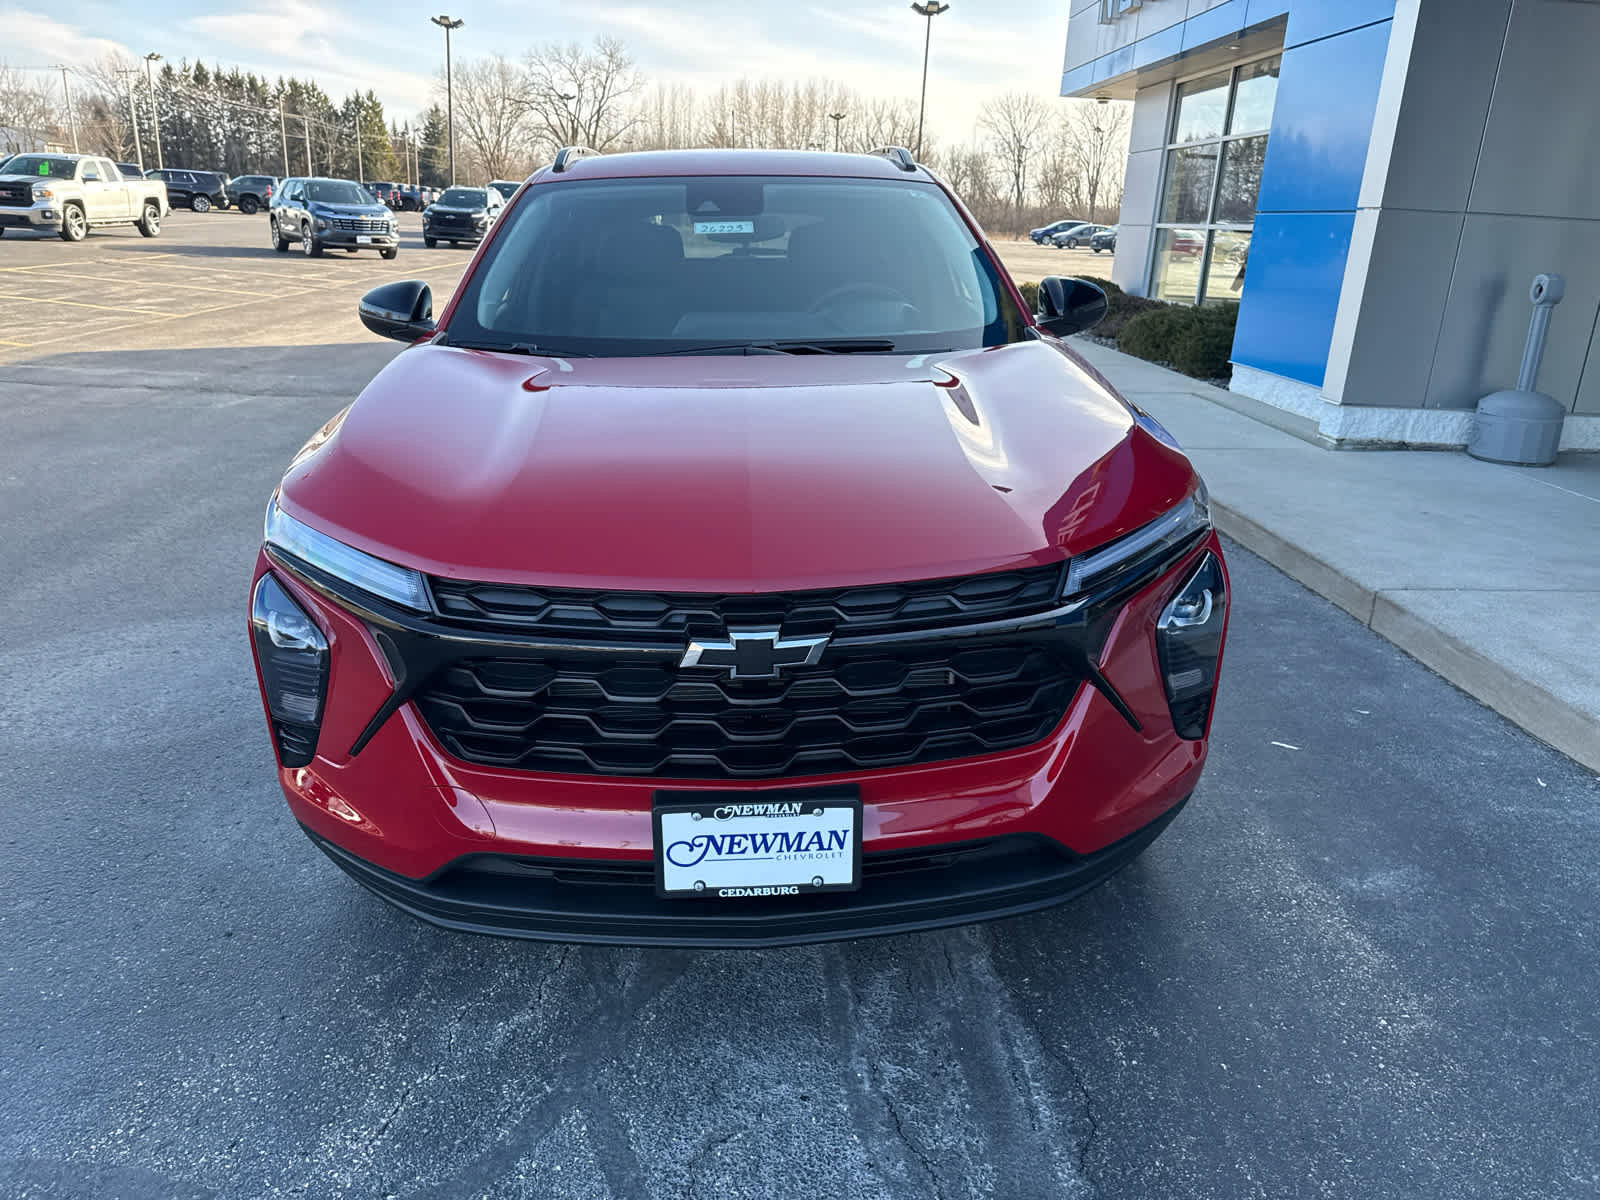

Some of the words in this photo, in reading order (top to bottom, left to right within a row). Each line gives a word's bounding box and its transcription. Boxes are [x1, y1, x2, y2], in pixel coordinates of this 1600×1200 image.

[714, 803, 802, 821] NEWMAN
[666, 829, 849, 867] NEWMAN
[776, 852, 843, 861] CHEVROLET
[718, 886, 799, 897] CEDARBURG
